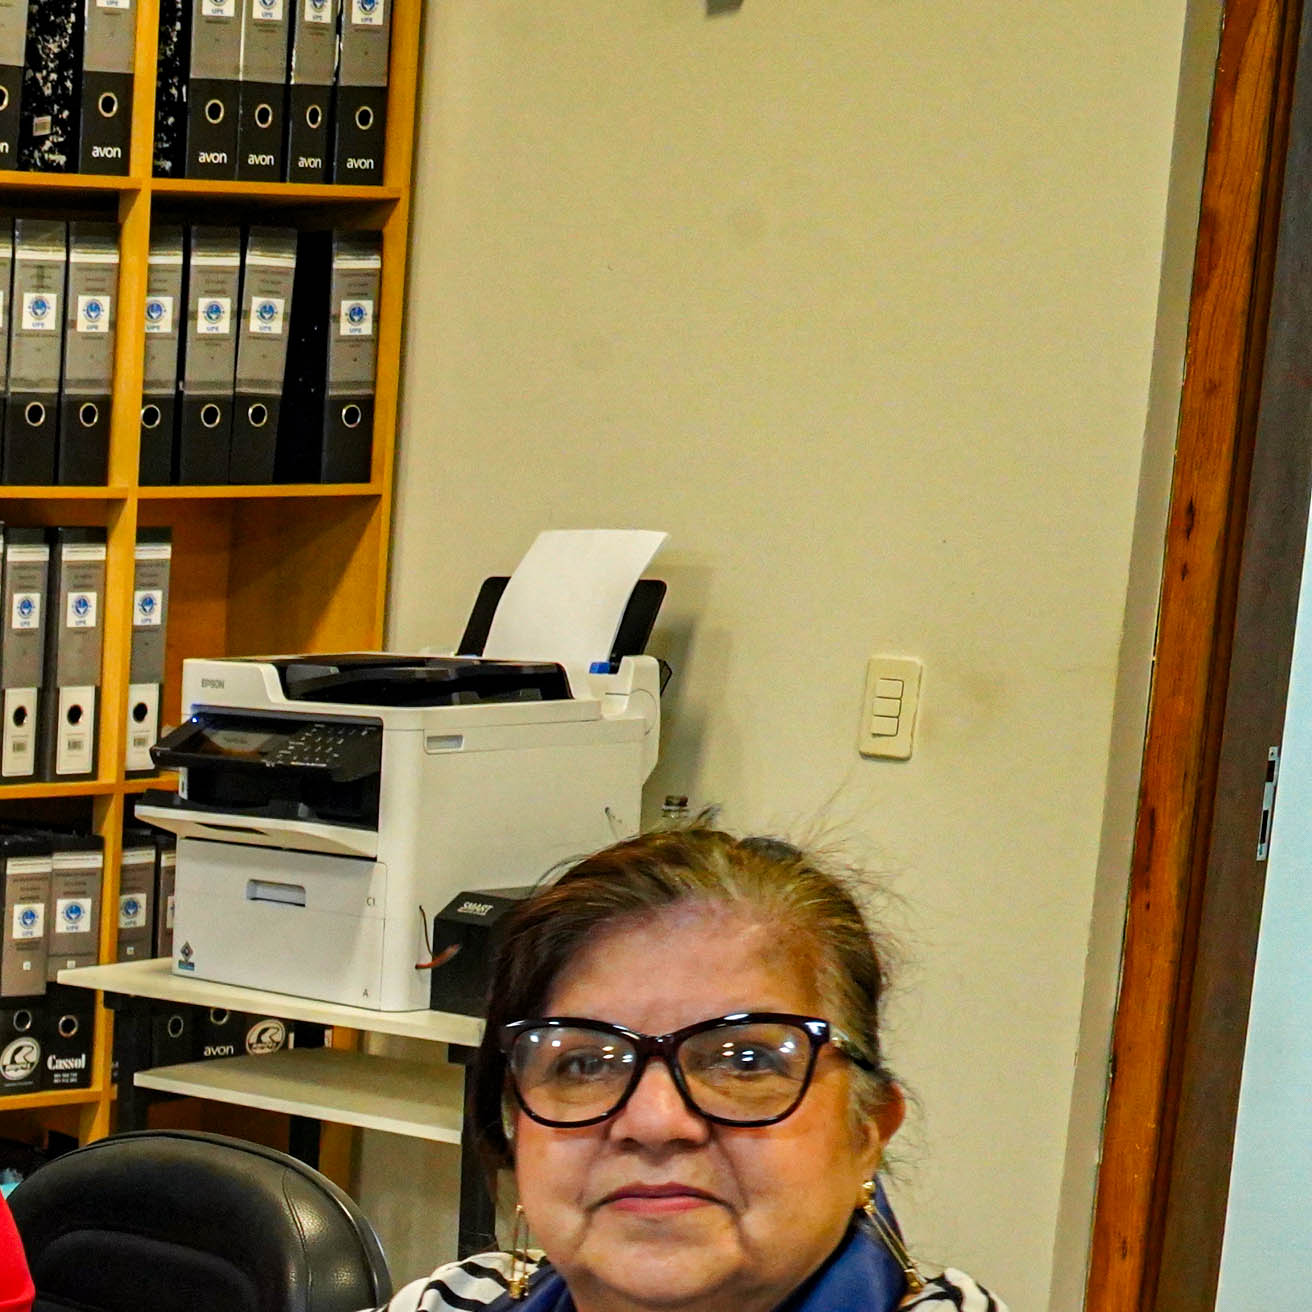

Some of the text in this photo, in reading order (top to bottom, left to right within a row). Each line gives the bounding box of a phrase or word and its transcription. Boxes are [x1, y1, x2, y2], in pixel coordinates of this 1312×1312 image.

[91, 145, 122, 159] avon
[198, 151, 228, 164] avon
[247, 153, 275, 166] avon
[297, 156, 322, 169] avon
[346, 158, 374, 170] avon
[203, 1045, 234, 1057] avon
